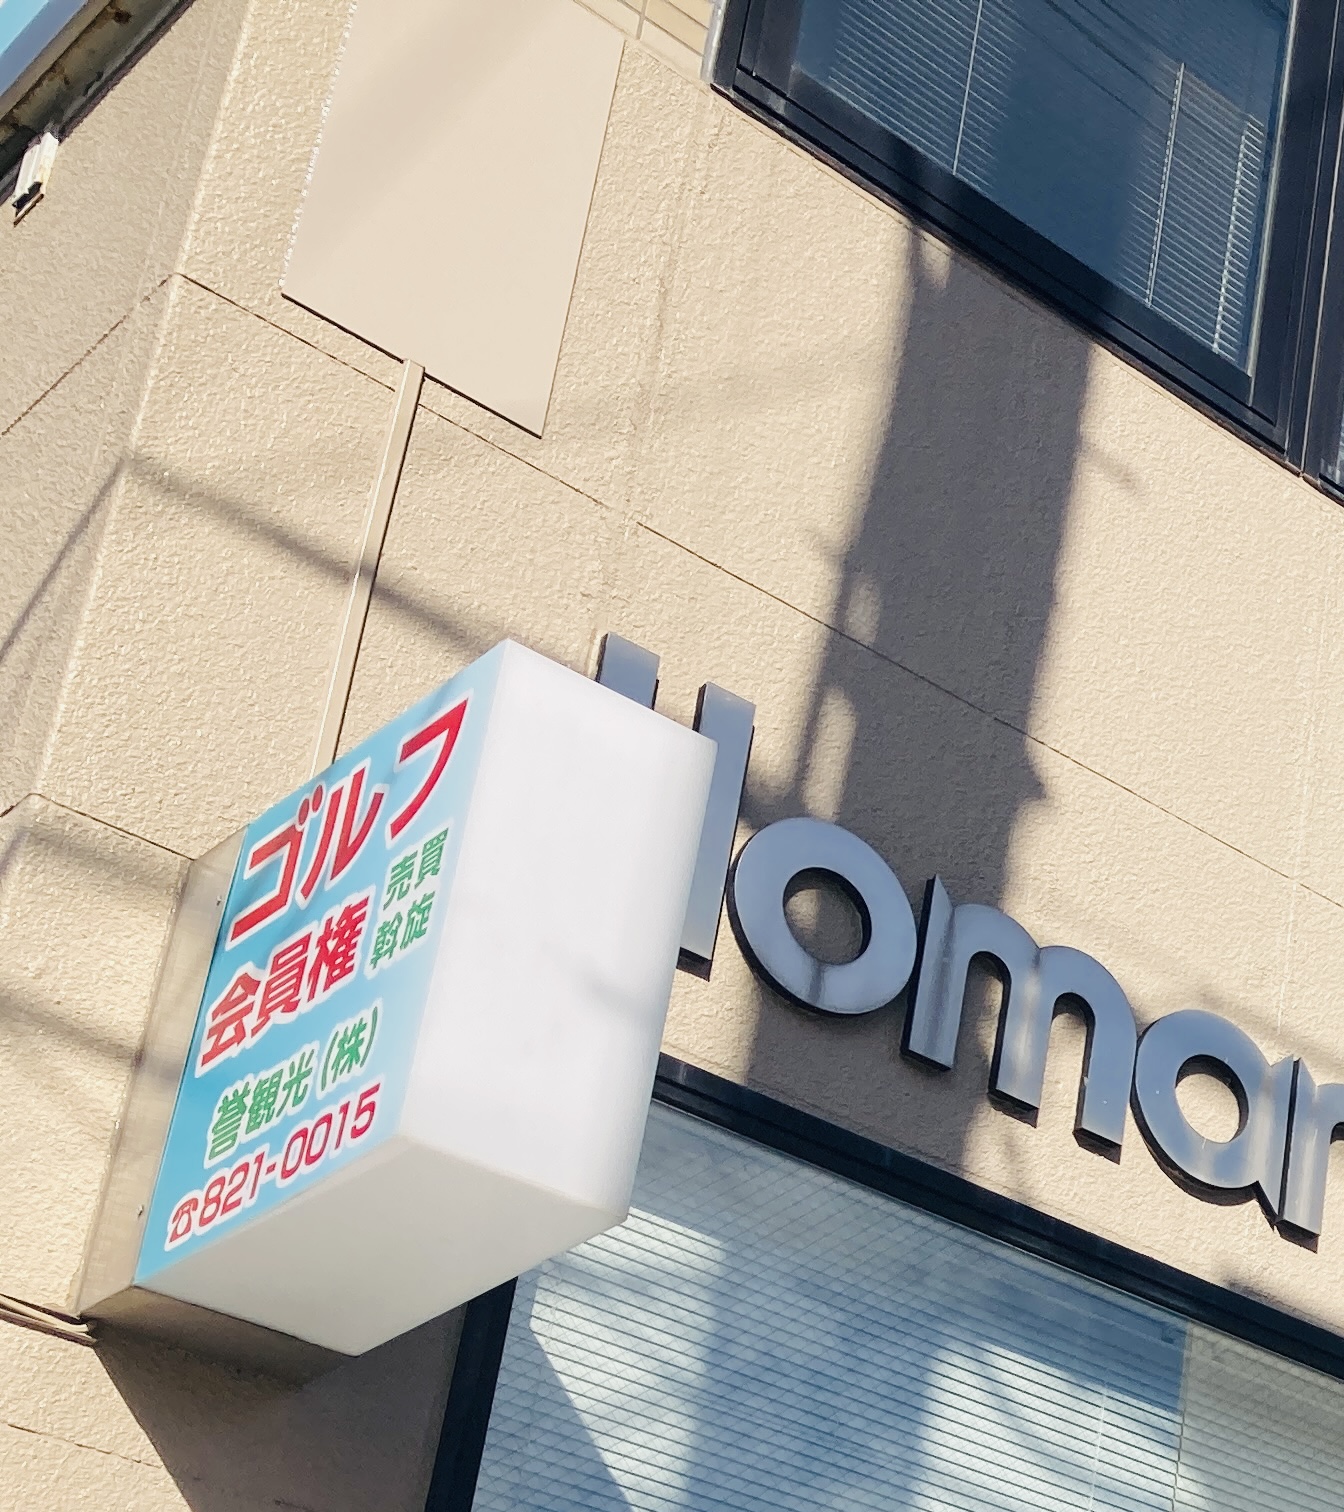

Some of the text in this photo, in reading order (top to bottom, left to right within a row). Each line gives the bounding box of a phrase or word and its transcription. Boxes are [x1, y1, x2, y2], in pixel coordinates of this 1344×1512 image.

[231, 697, 469, 941] ゴルフ
[383, 828, 449, 911] 売買
[202, 897, 370, 1067] 会員権
[199, 1085, 377, 1229] 821-0015
